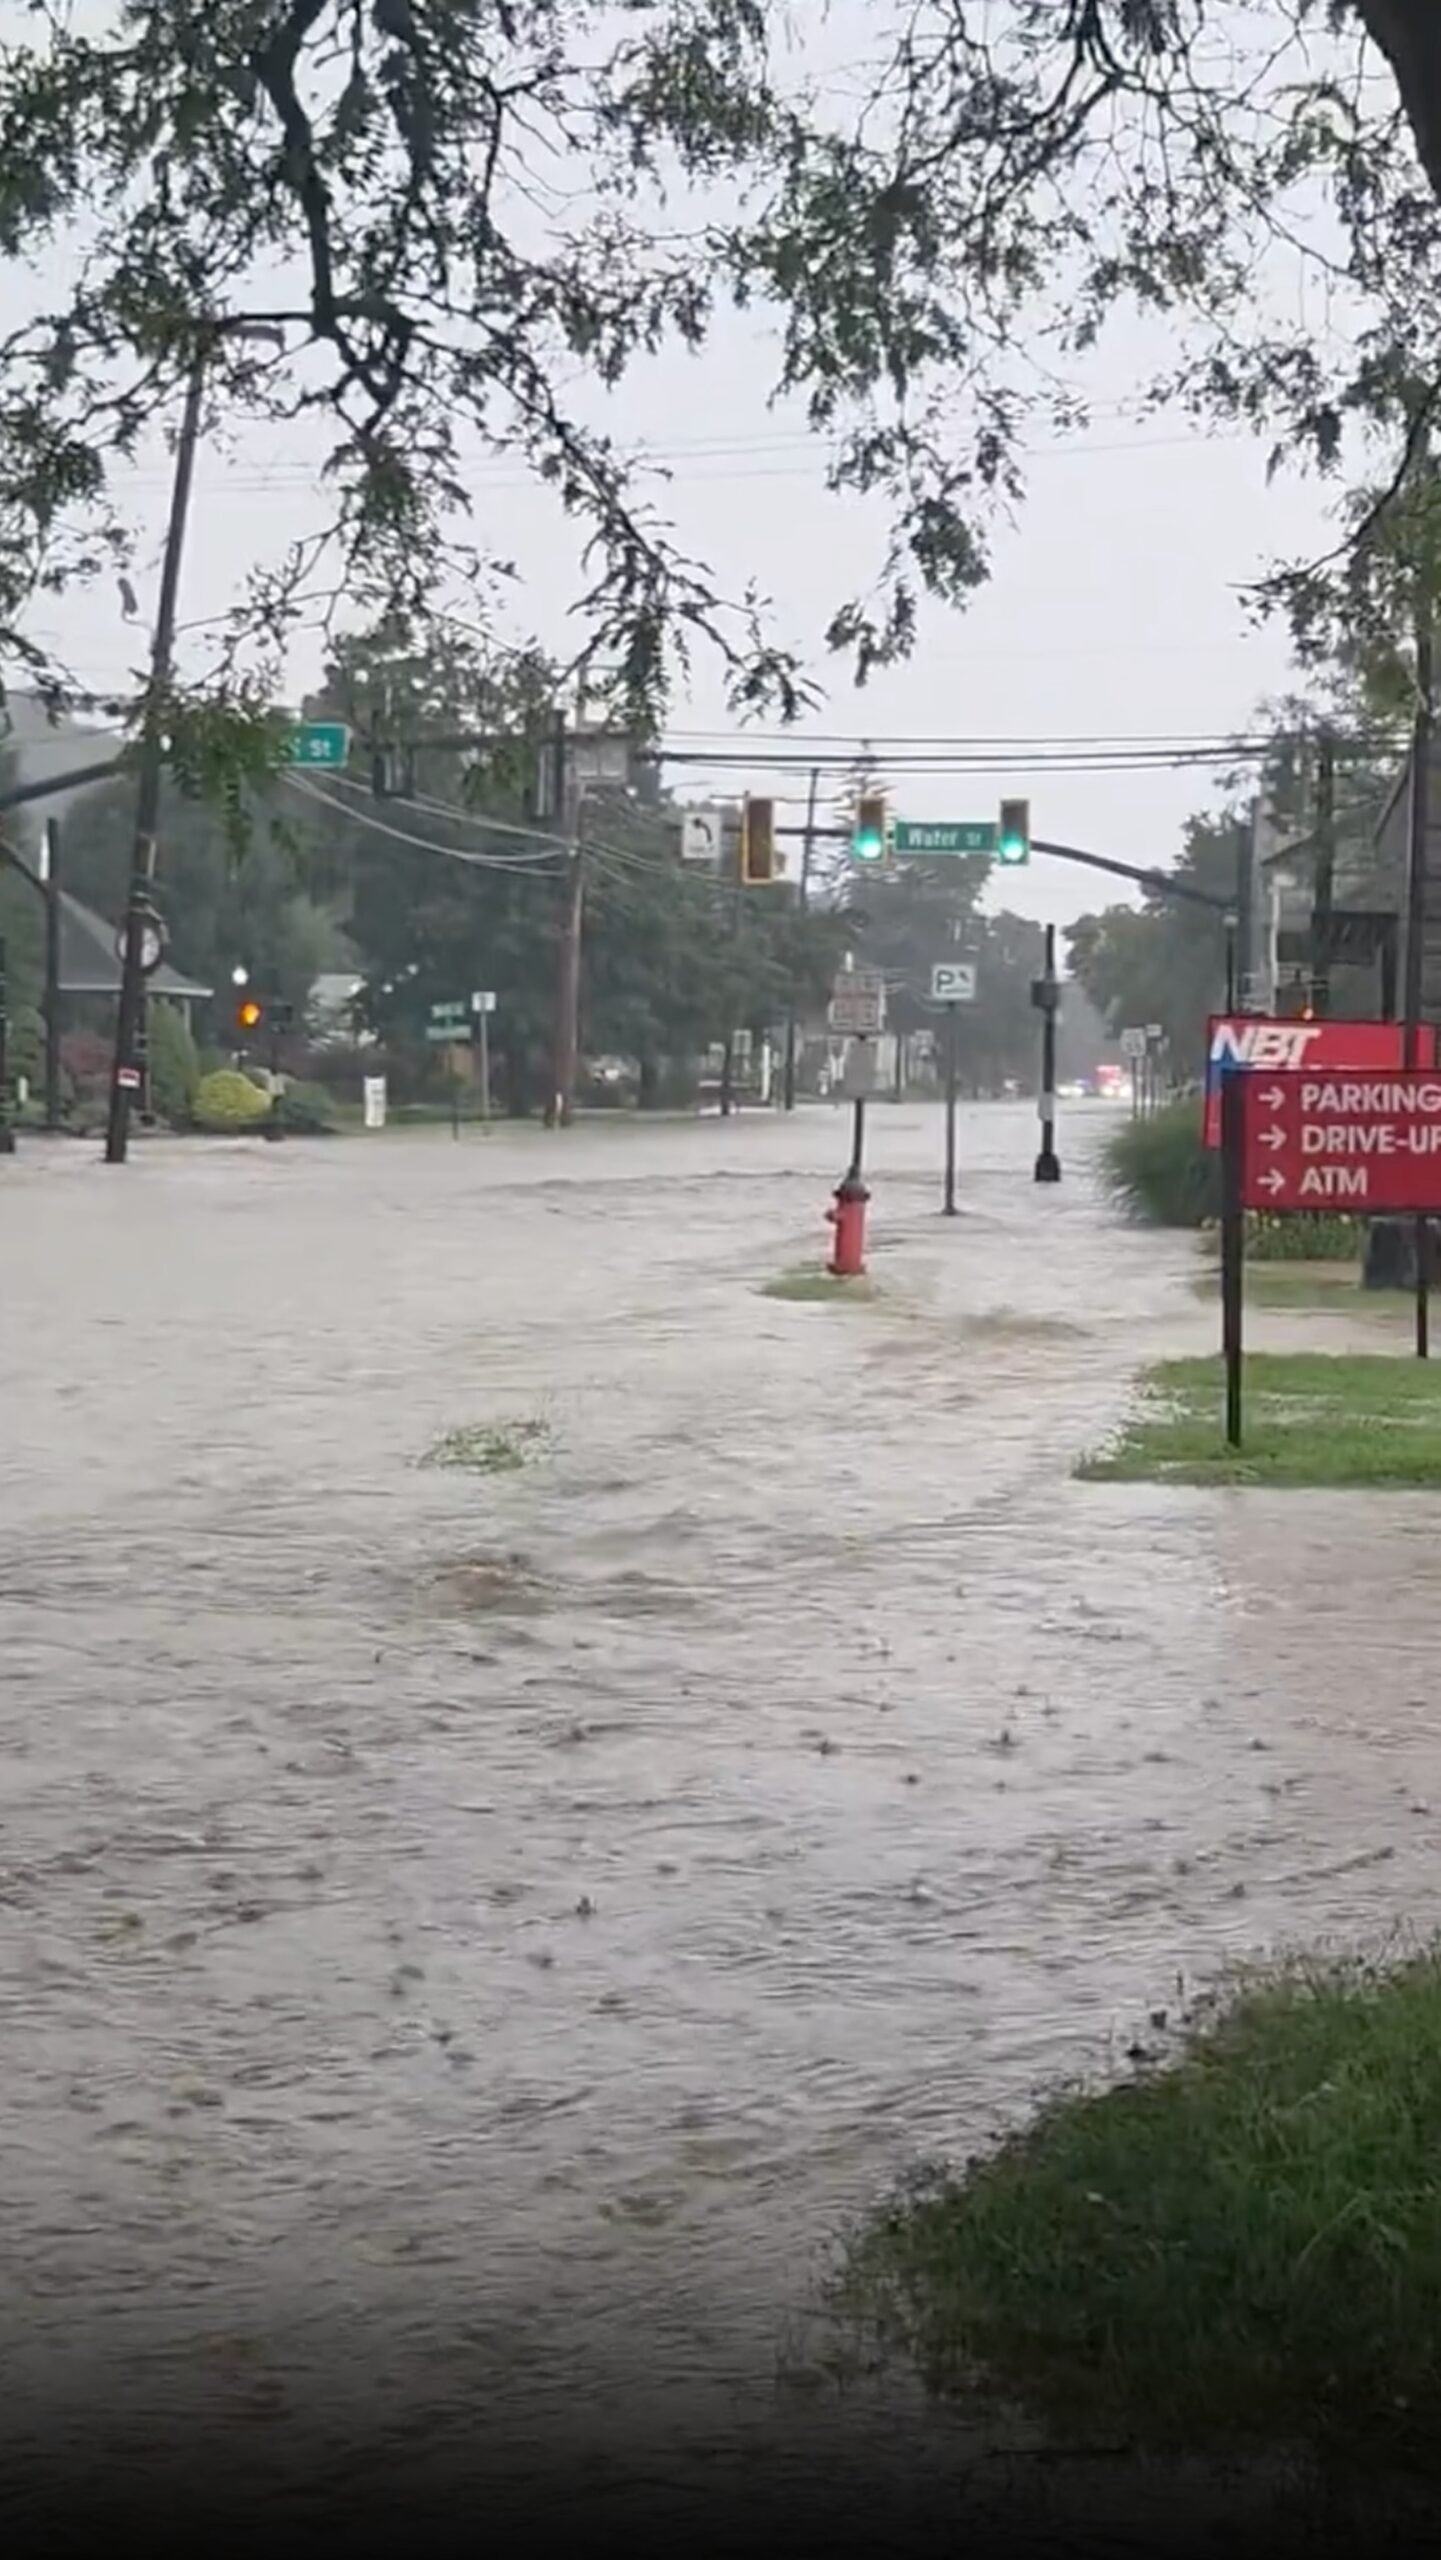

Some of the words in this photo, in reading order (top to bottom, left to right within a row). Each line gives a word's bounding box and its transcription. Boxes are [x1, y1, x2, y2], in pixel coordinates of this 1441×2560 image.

[309, 738, 331, 757] St
[908, 828, 958, 847] Water
[935, 968, 955, 993] P
[1210, 1024, 1322, 1063] NBT
[1301, 1082, 1441, 1113] PARKING
[1299, 1165, 1368, 1196] ATM
